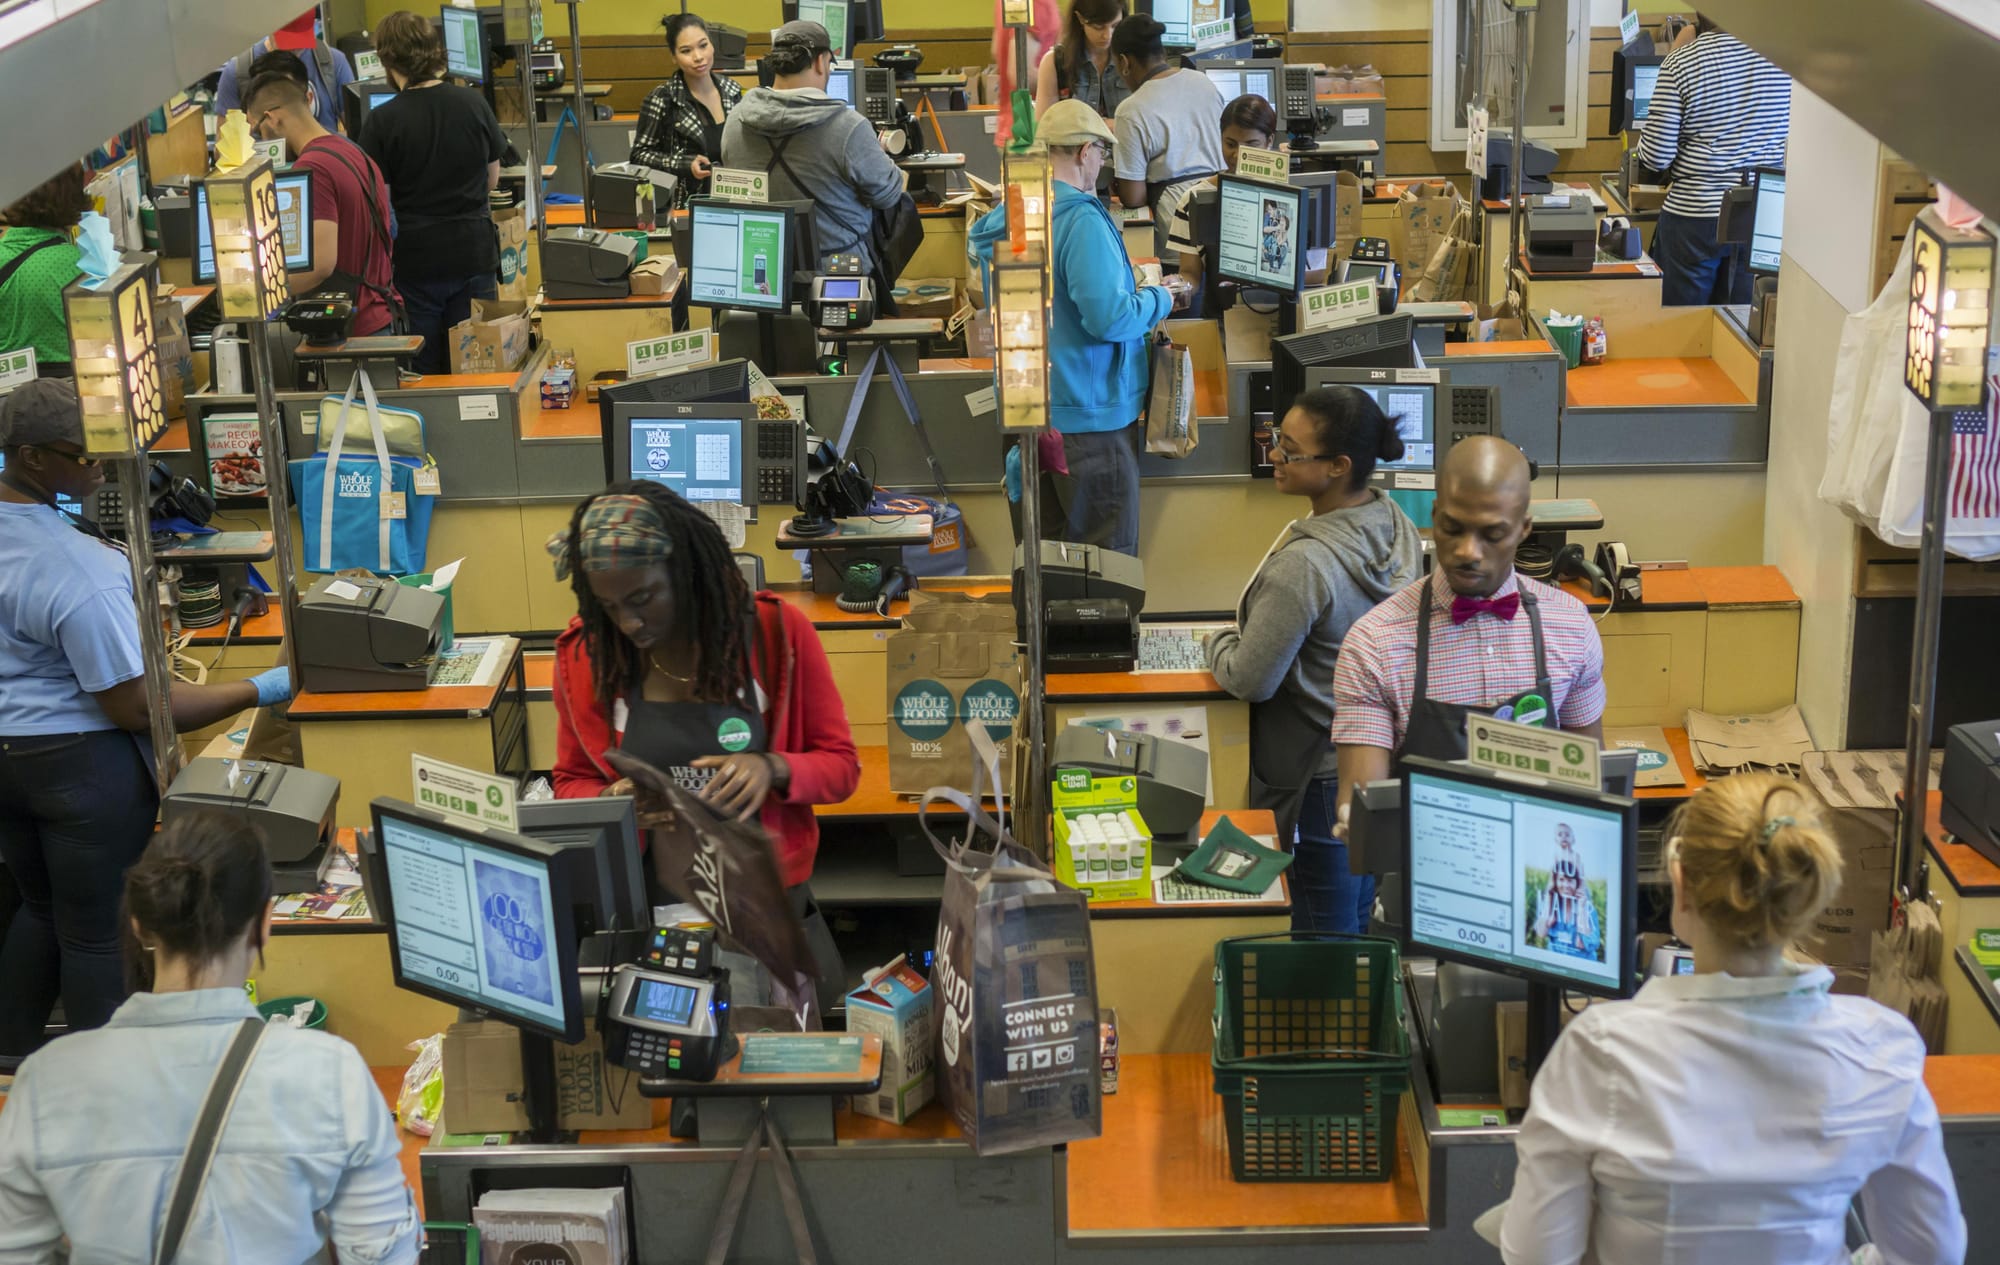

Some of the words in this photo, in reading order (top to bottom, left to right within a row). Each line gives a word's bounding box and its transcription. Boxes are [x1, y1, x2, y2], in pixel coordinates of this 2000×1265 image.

[257, 182, 277, 228] 10
[712, 288, 726, 297] 0.00
[133, 286, 148, 345] 4
[1370, 370, 1387, 379] IBM
[677, 406, 693, 414] IBM
[227, 430, 258, 440] RECIP
[339, 474, 373, 485] WHOLE
[341, 484, 371, 493] FOODS
[900, 696, 950, 710] WHOLE
[966, 696, 1015, 710] WHOLE
[903, 708, 948, 720] FOODS
[970, 708, 1012, 720] FOODS
[910, 742, 942, 753] 100%
[1060, 774, 1087, 782] Clean
[1067, 780, 1088, 789] Well
[1457, 927, 1487, 945] 0.00
[435, 965, 460, 984] 0.00
[1005, 1003, 1075, 1026] CONNECT
[1005, 1023, 1044, 1041] WITH
[1050, 1020, 1069, 1034] US
[560, 1050, 577, 1119] WHOLE
[576, 1053, 594, 1114] FOODS
[476, 1220, 563, 1244] Psychology
[562, 1220, 606, 1244] Today
